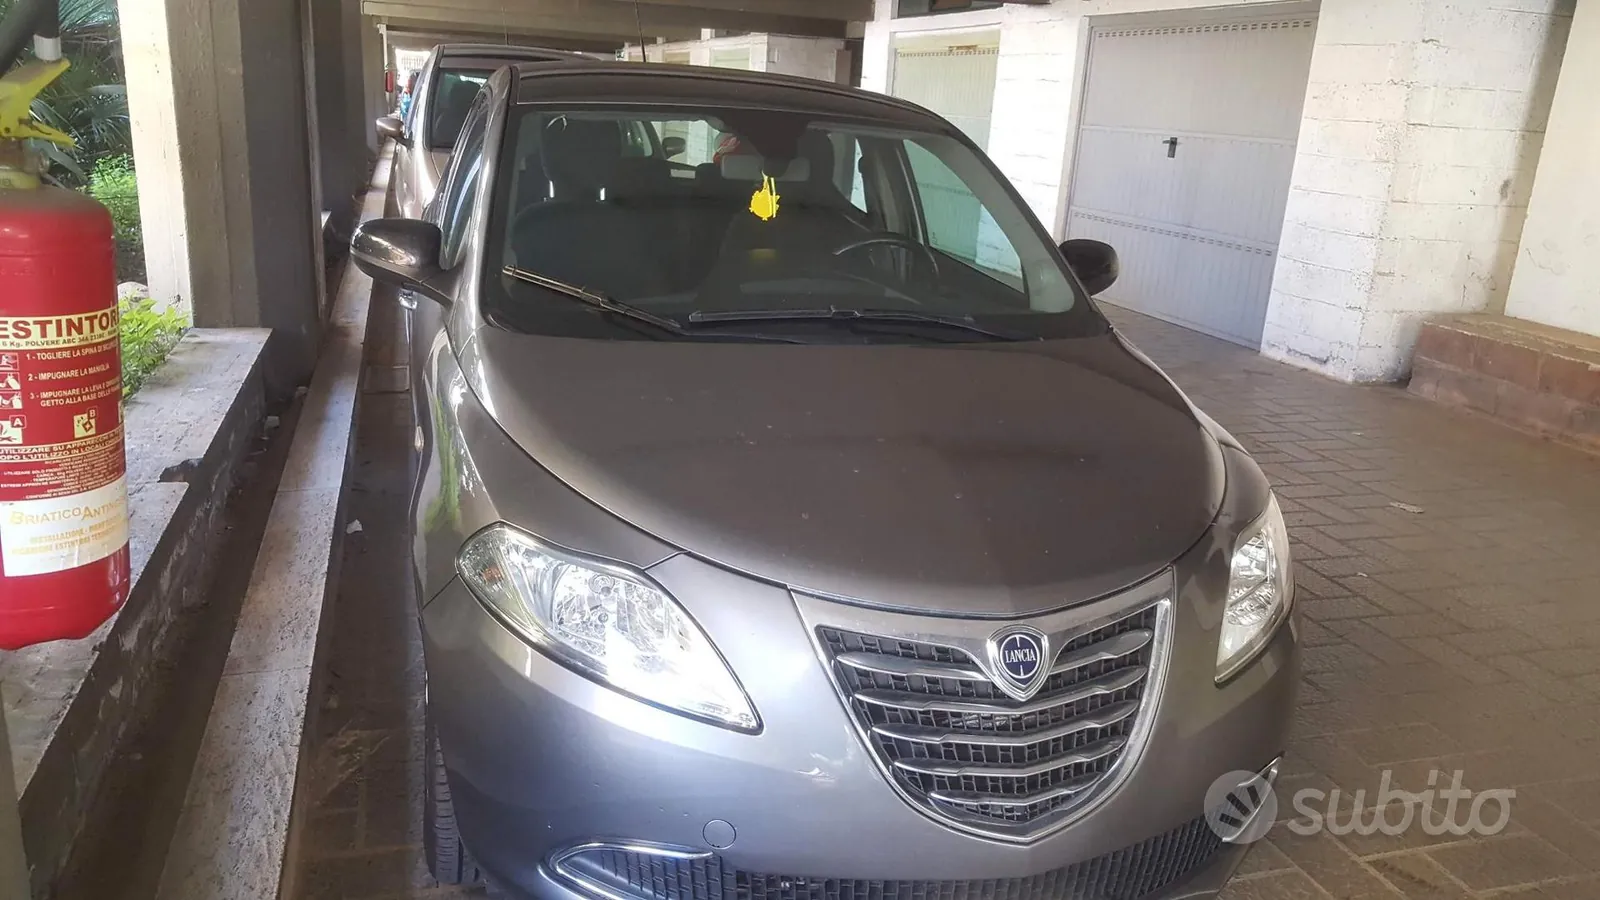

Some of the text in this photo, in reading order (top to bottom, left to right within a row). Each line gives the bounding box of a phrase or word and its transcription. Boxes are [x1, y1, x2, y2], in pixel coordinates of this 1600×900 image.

[0, 310, 119, 339] ESTINTOR
[25, 339, 60, 347] POLVERE
[62, 337, 76, 345] ABC
[36, 351, 71, 360] TOGLIERE
[81, 346, 97, 355] SPINA
[28, 373, 33, 381] 2
[39, 369, 79, 380] IMPUGNARE
[80, 368, 87, 376] LA
[29, 392, 35, 400] 3
[40, 388, 80, 399] IMPUGNARE
[81, 386, 89, 394] LA
[40, 399, 64, 407] GETTO
[65, 396, 82, 405] ALLA
[83, 392, 97, 402] BASE
[89, 410, 96, 419] B
[13, 417, 23, 427] A
[1005, 648, 1036, 663] LANCIA
